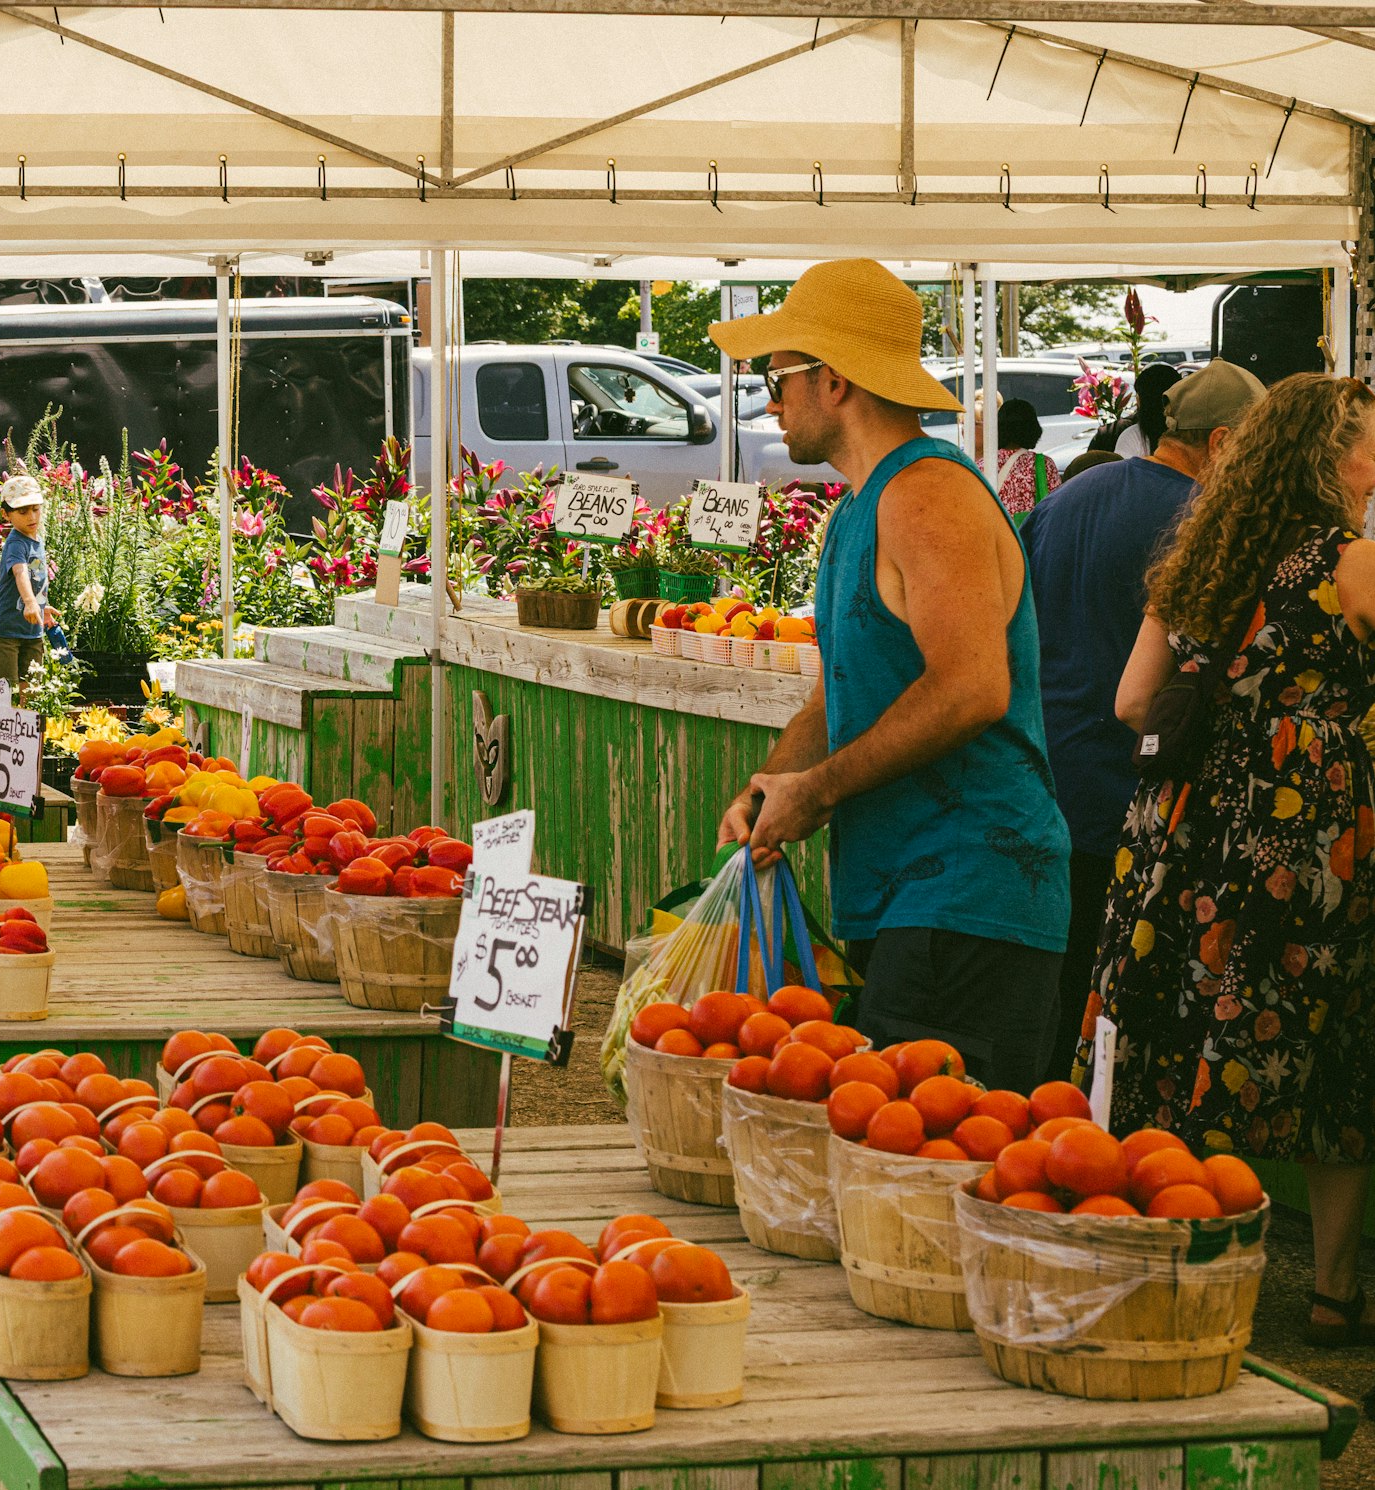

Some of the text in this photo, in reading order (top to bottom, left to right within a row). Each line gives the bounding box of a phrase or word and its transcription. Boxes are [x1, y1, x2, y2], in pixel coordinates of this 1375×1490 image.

[568, 491, 627, 515] BEANS
[703, 489, 750, 517] BEANS
[15, 711, 38, 739] BELL
[490, 916, 540, 939] TOMATOES
